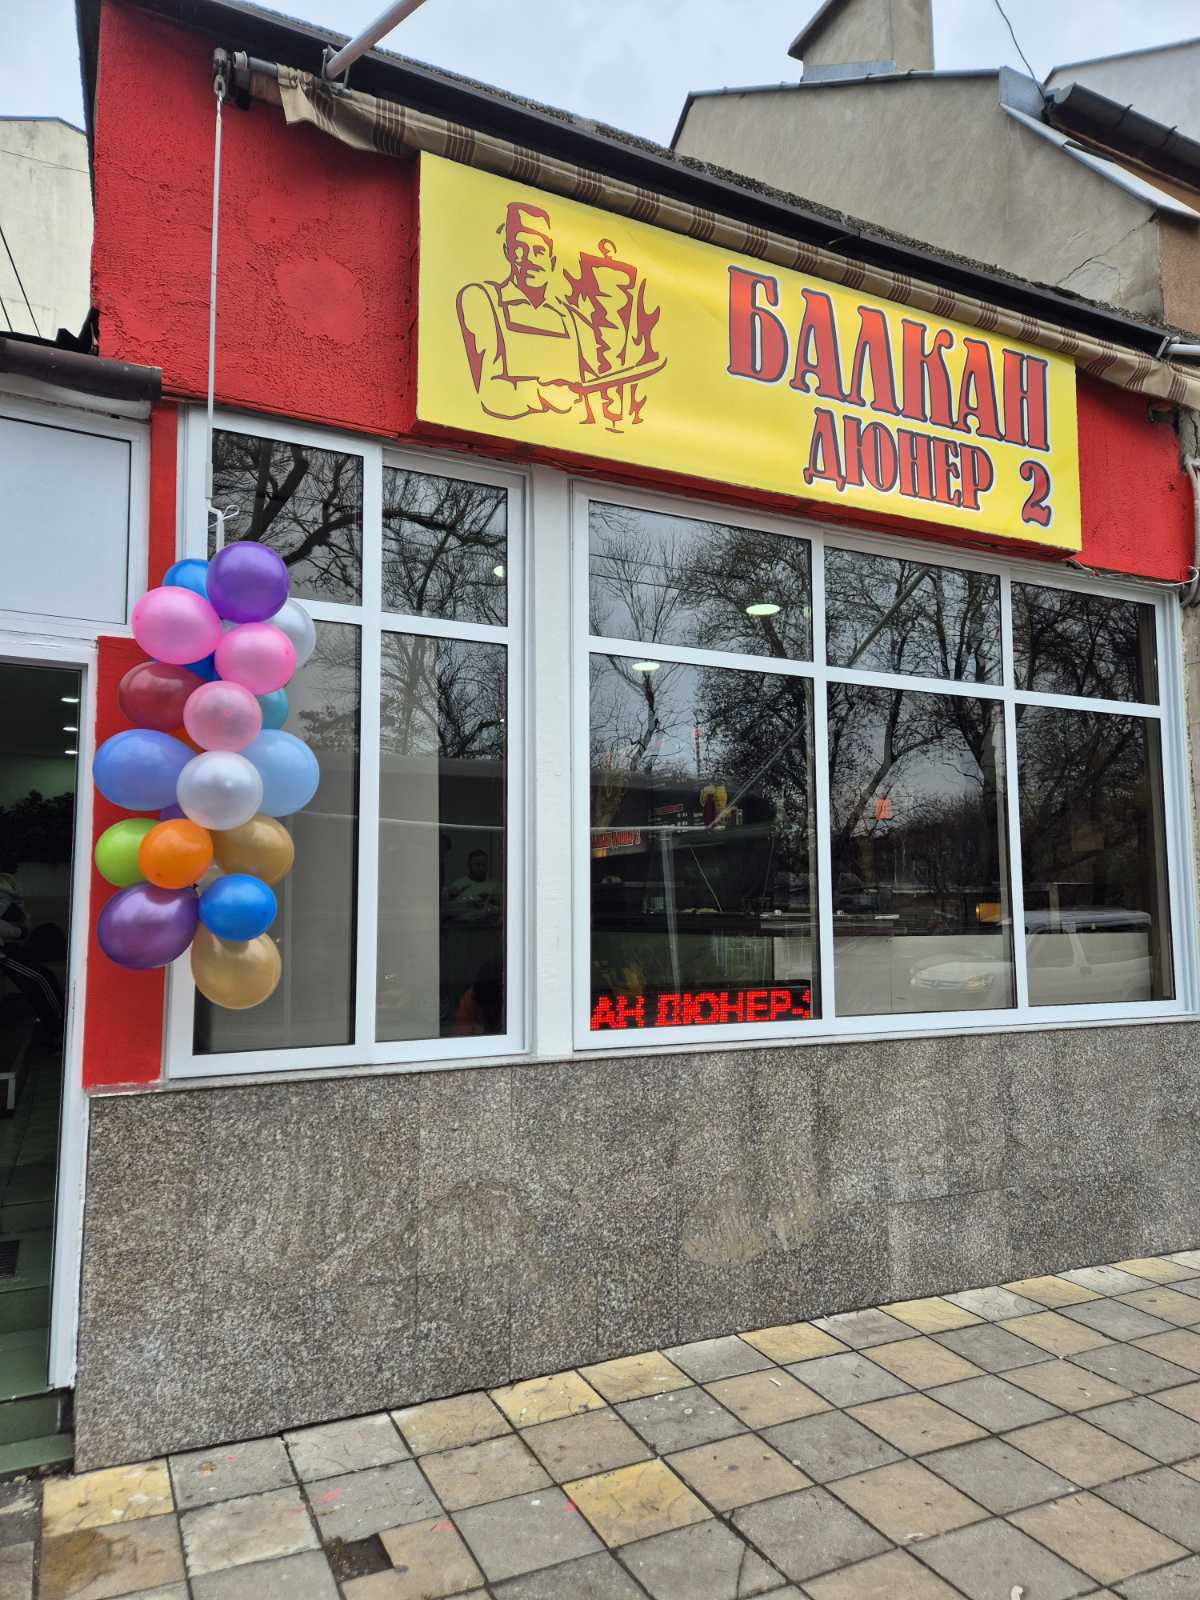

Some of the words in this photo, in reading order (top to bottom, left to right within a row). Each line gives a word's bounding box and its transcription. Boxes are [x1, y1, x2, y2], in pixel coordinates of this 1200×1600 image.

[727, 265, 1050, 451] БАЛКАН
[803, 406, 994, 511] ДЮНЕР
[1019, 460, 1053, 527] 2
